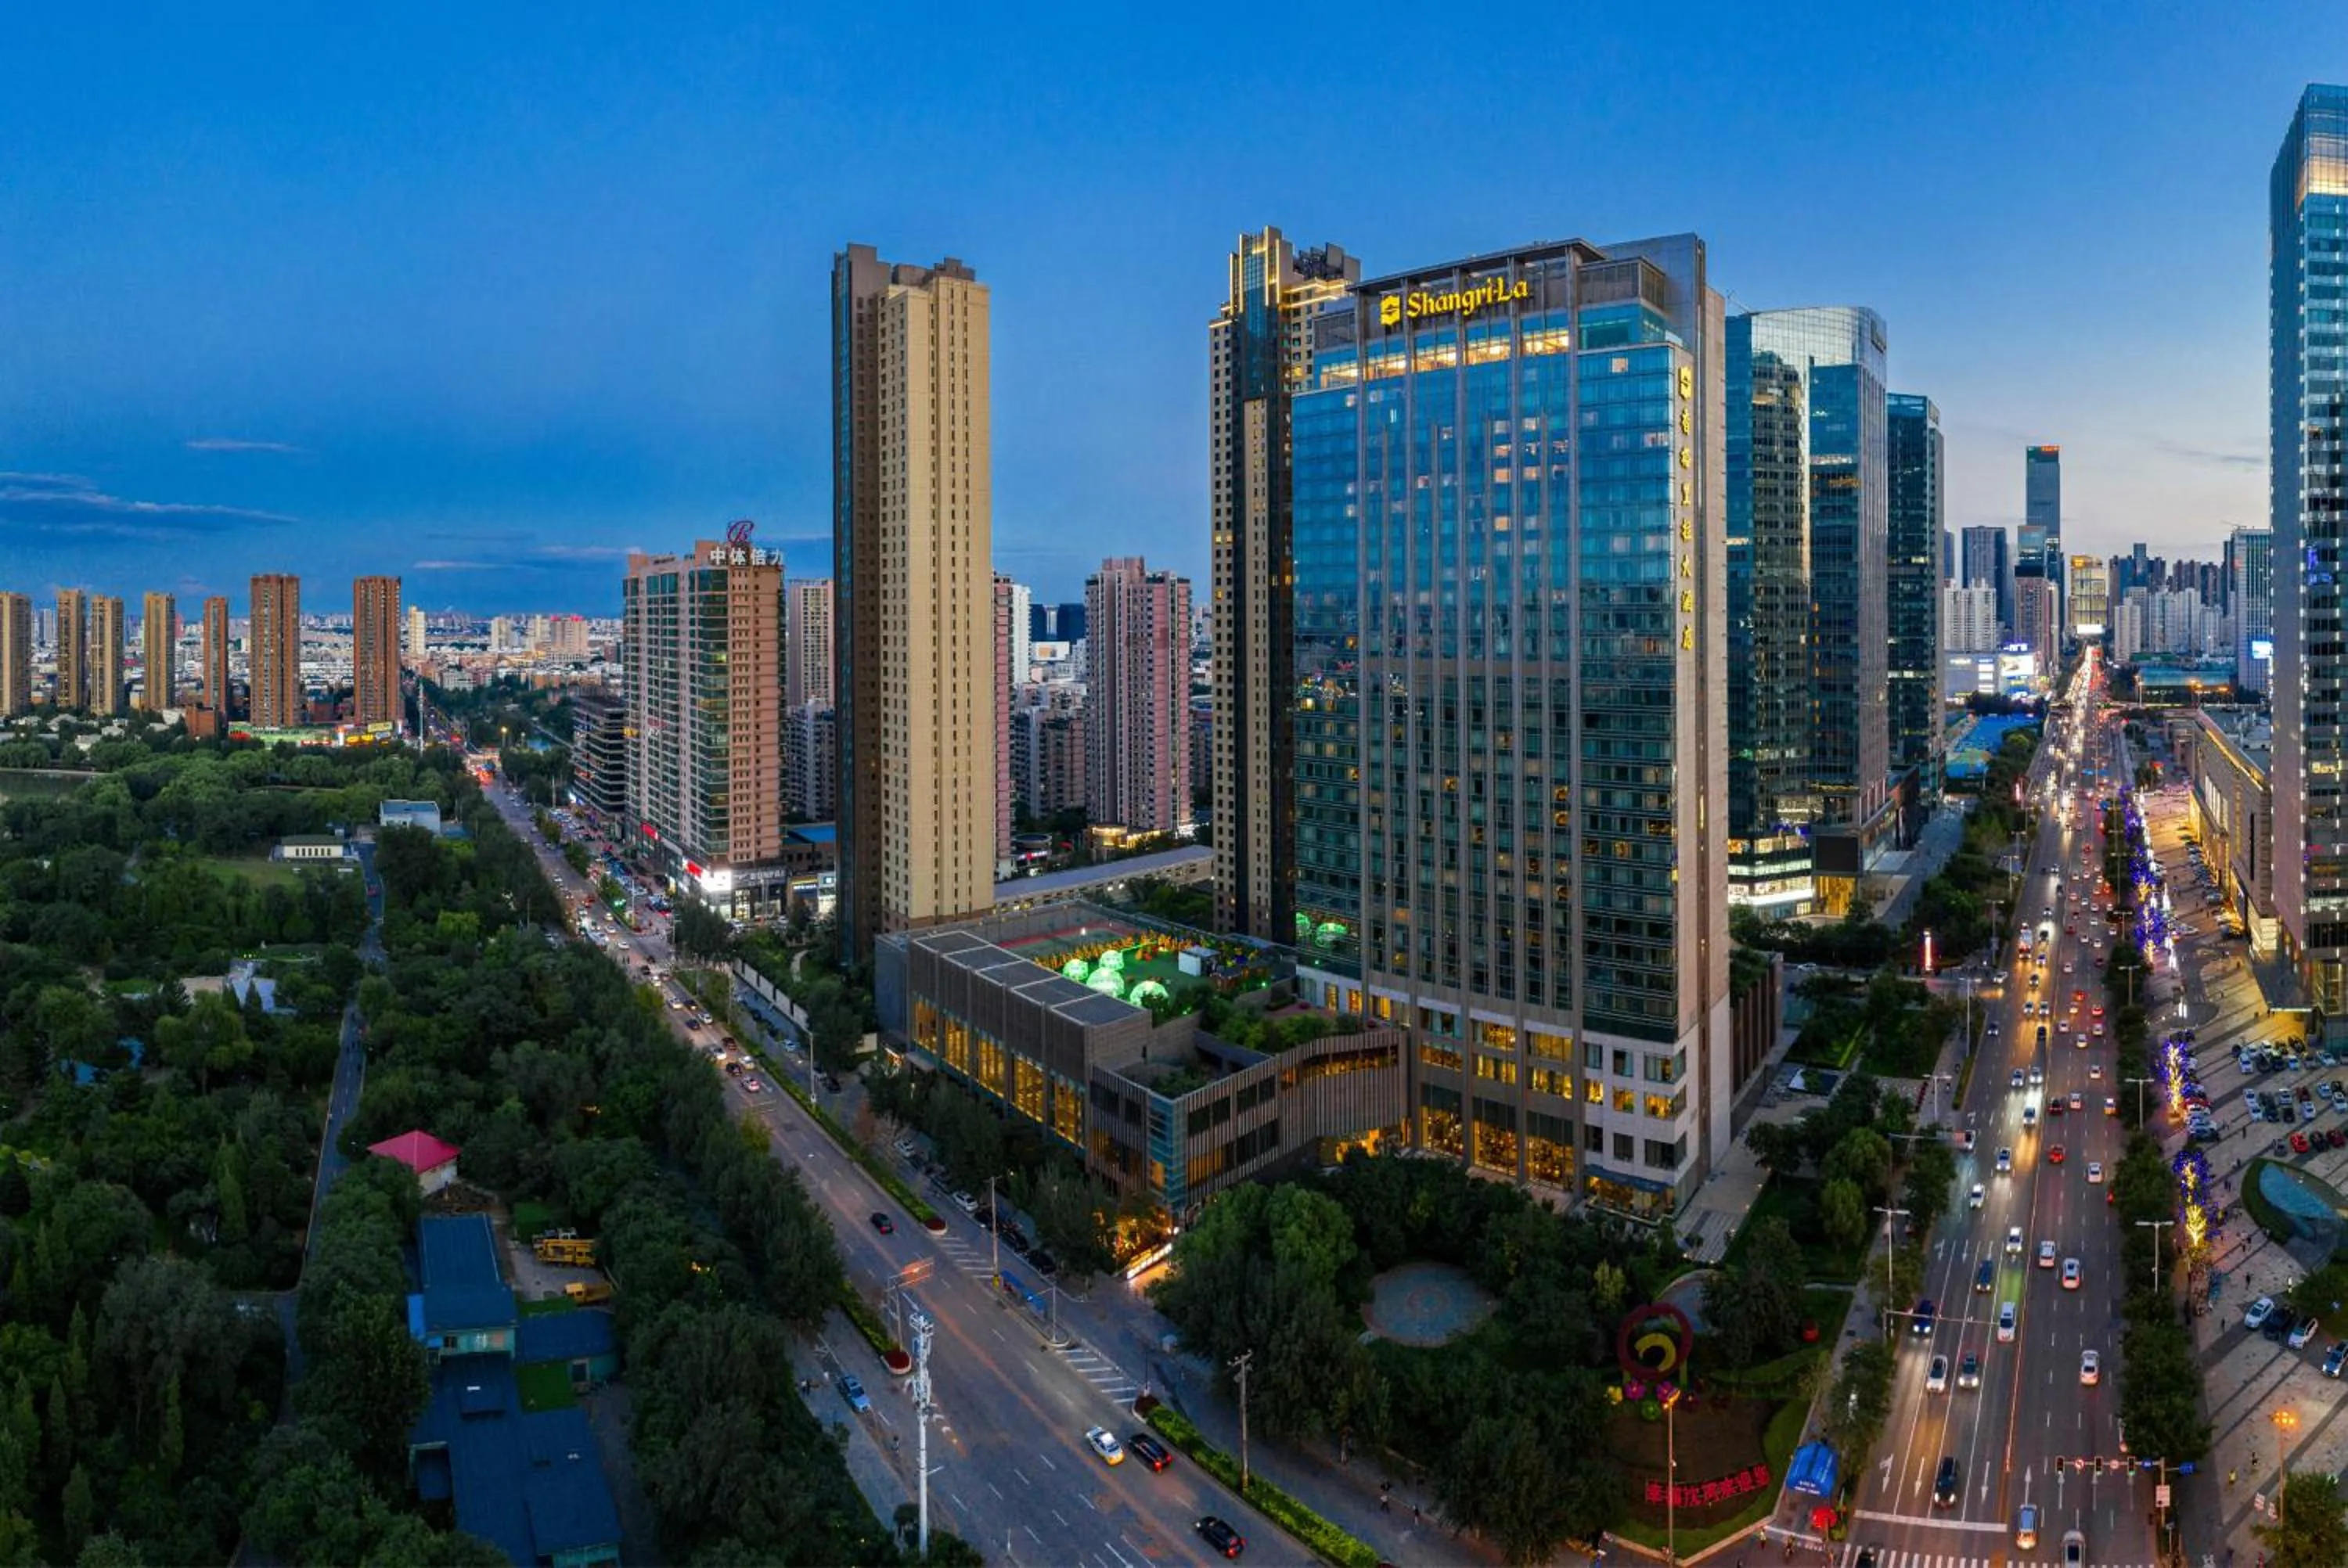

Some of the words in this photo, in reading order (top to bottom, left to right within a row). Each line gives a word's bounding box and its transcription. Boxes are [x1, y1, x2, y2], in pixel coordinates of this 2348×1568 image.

[1407, 276, 1528, 318] Shangri-La
[1680, 408, 1693, 650] 香格里拉大酒店
[710, 547, 783, 566] 中体倍力
